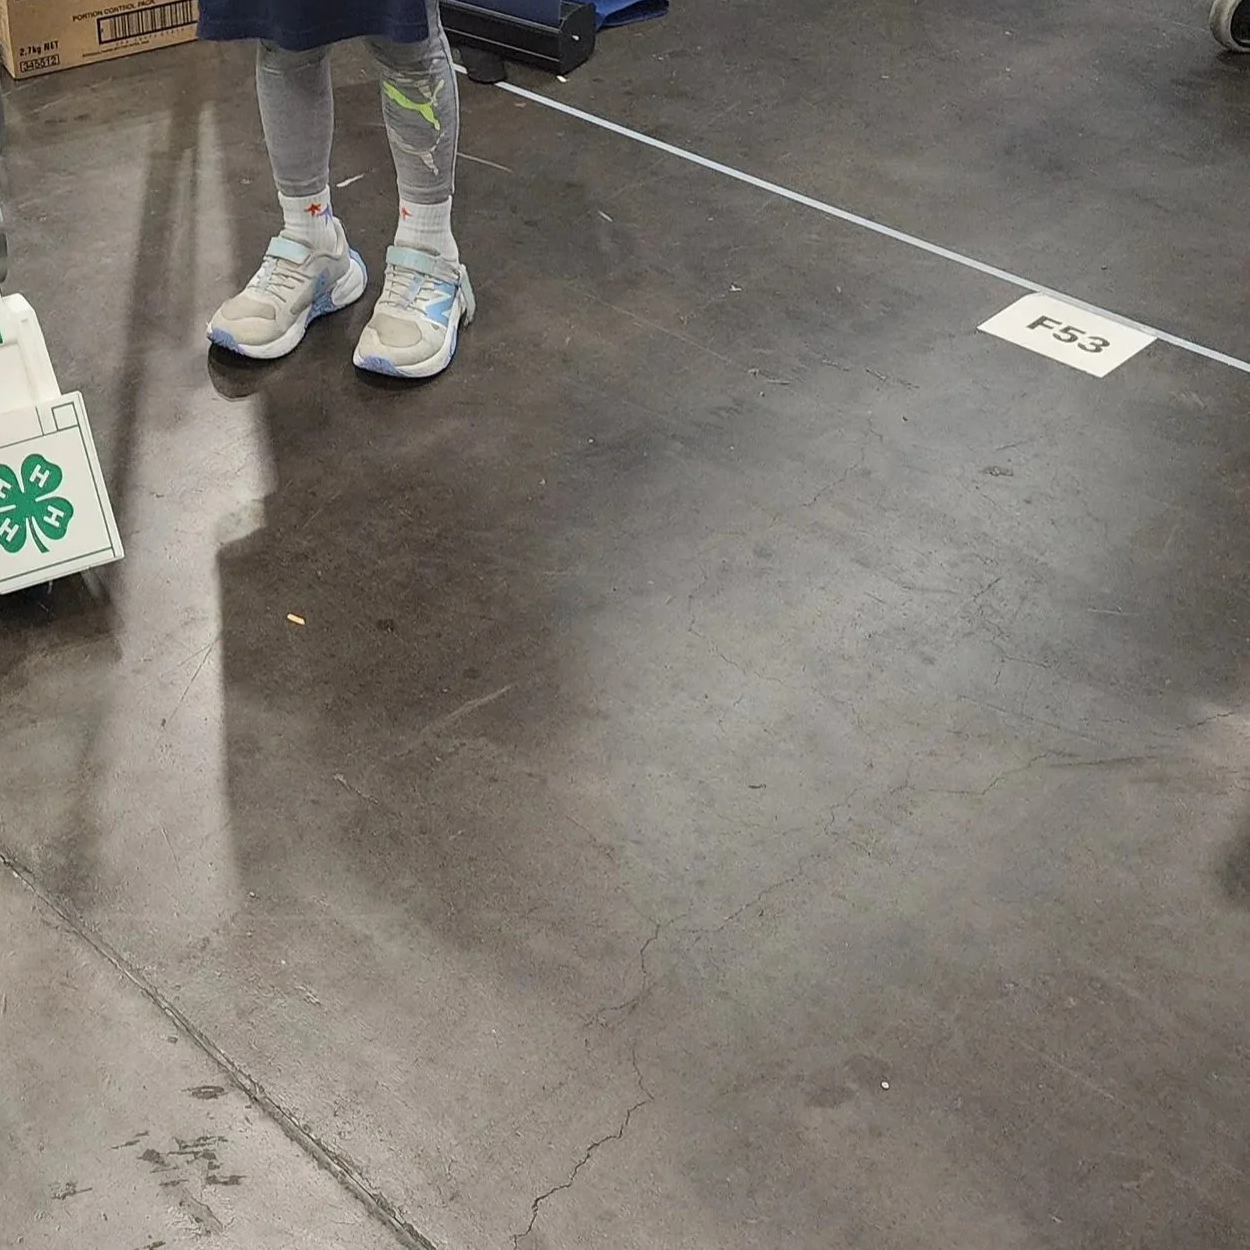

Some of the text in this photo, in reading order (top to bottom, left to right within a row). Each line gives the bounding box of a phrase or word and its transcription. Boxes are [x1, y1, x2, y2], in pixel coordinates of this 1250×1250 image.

[72, 9, 103, 23] PORTION
[104, 2, 136, 15] CONTROL
[19, 40, 59, 57] 2.7kg NET
[1026, 315, 1110, 354] F53
[29, 464, 50, 488] H
[43, 505, 64, 528] H
